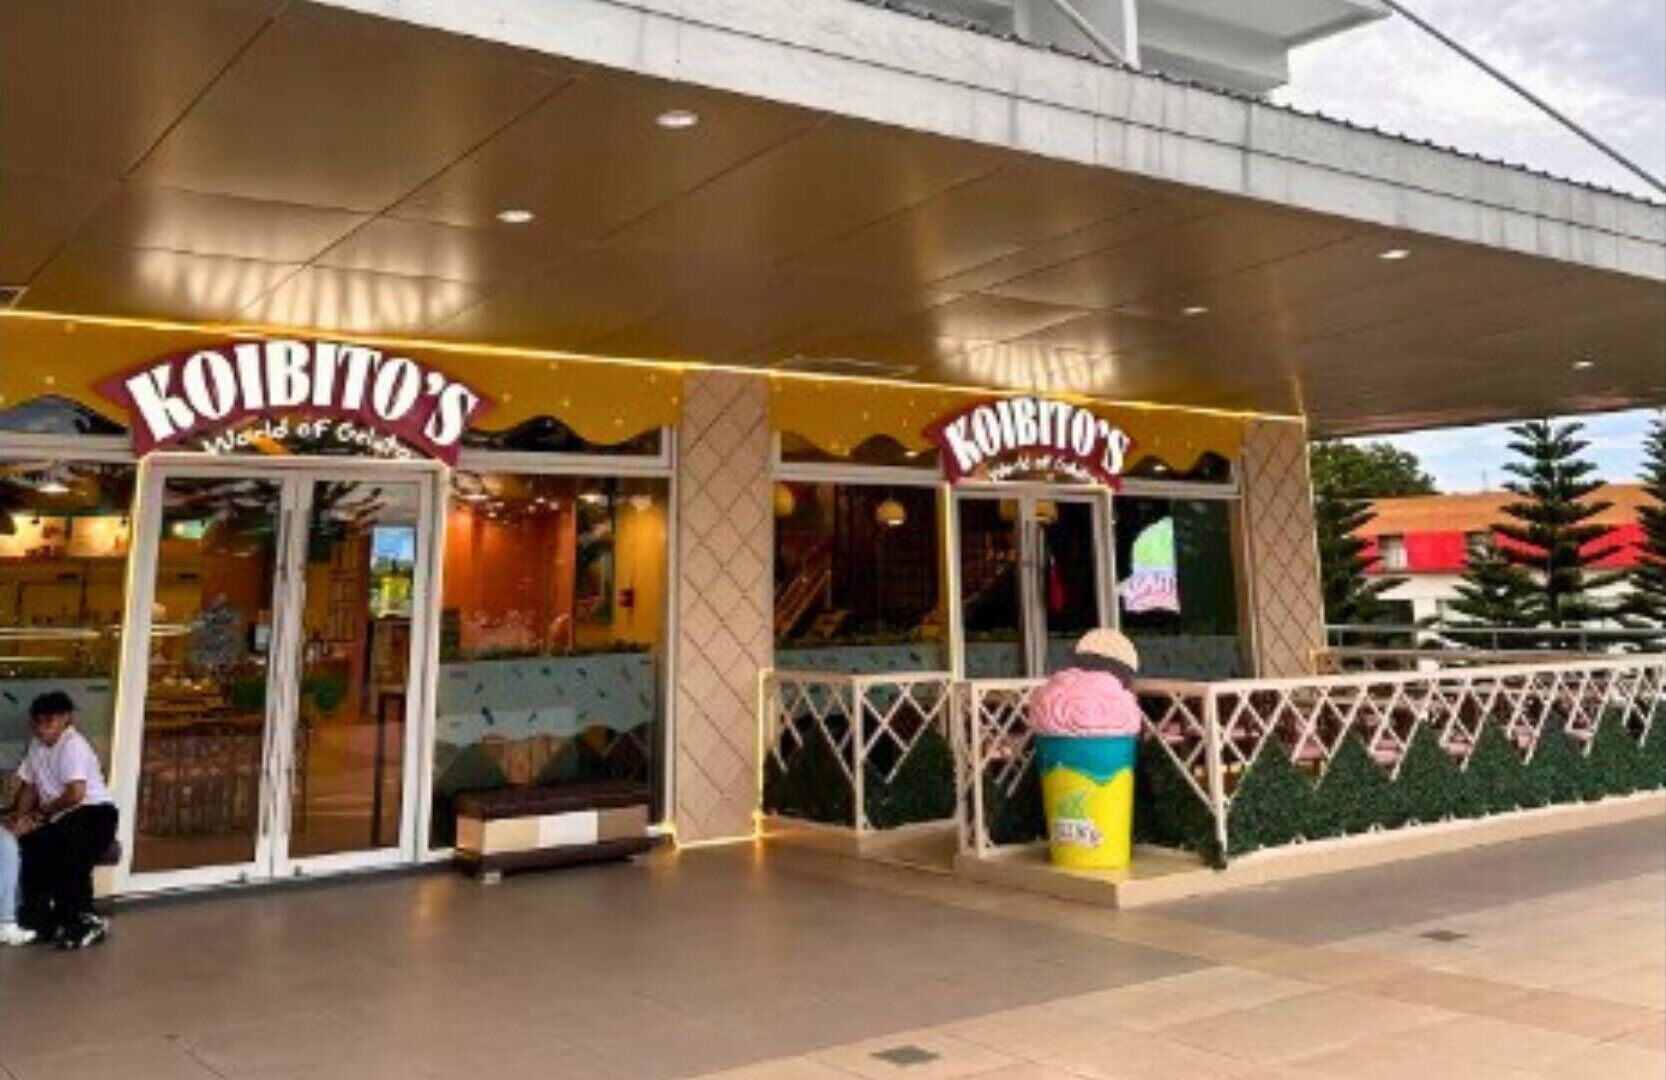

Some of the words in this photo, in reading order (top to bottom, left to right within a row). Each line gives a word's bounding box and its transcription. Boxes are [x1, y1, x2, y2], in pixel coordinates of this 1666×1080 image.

[125, 339, 480, 445] KOIBITO'S
[202, 416, 289, 456] World
[945, 397, 1131, 474] KOIBITO'S
